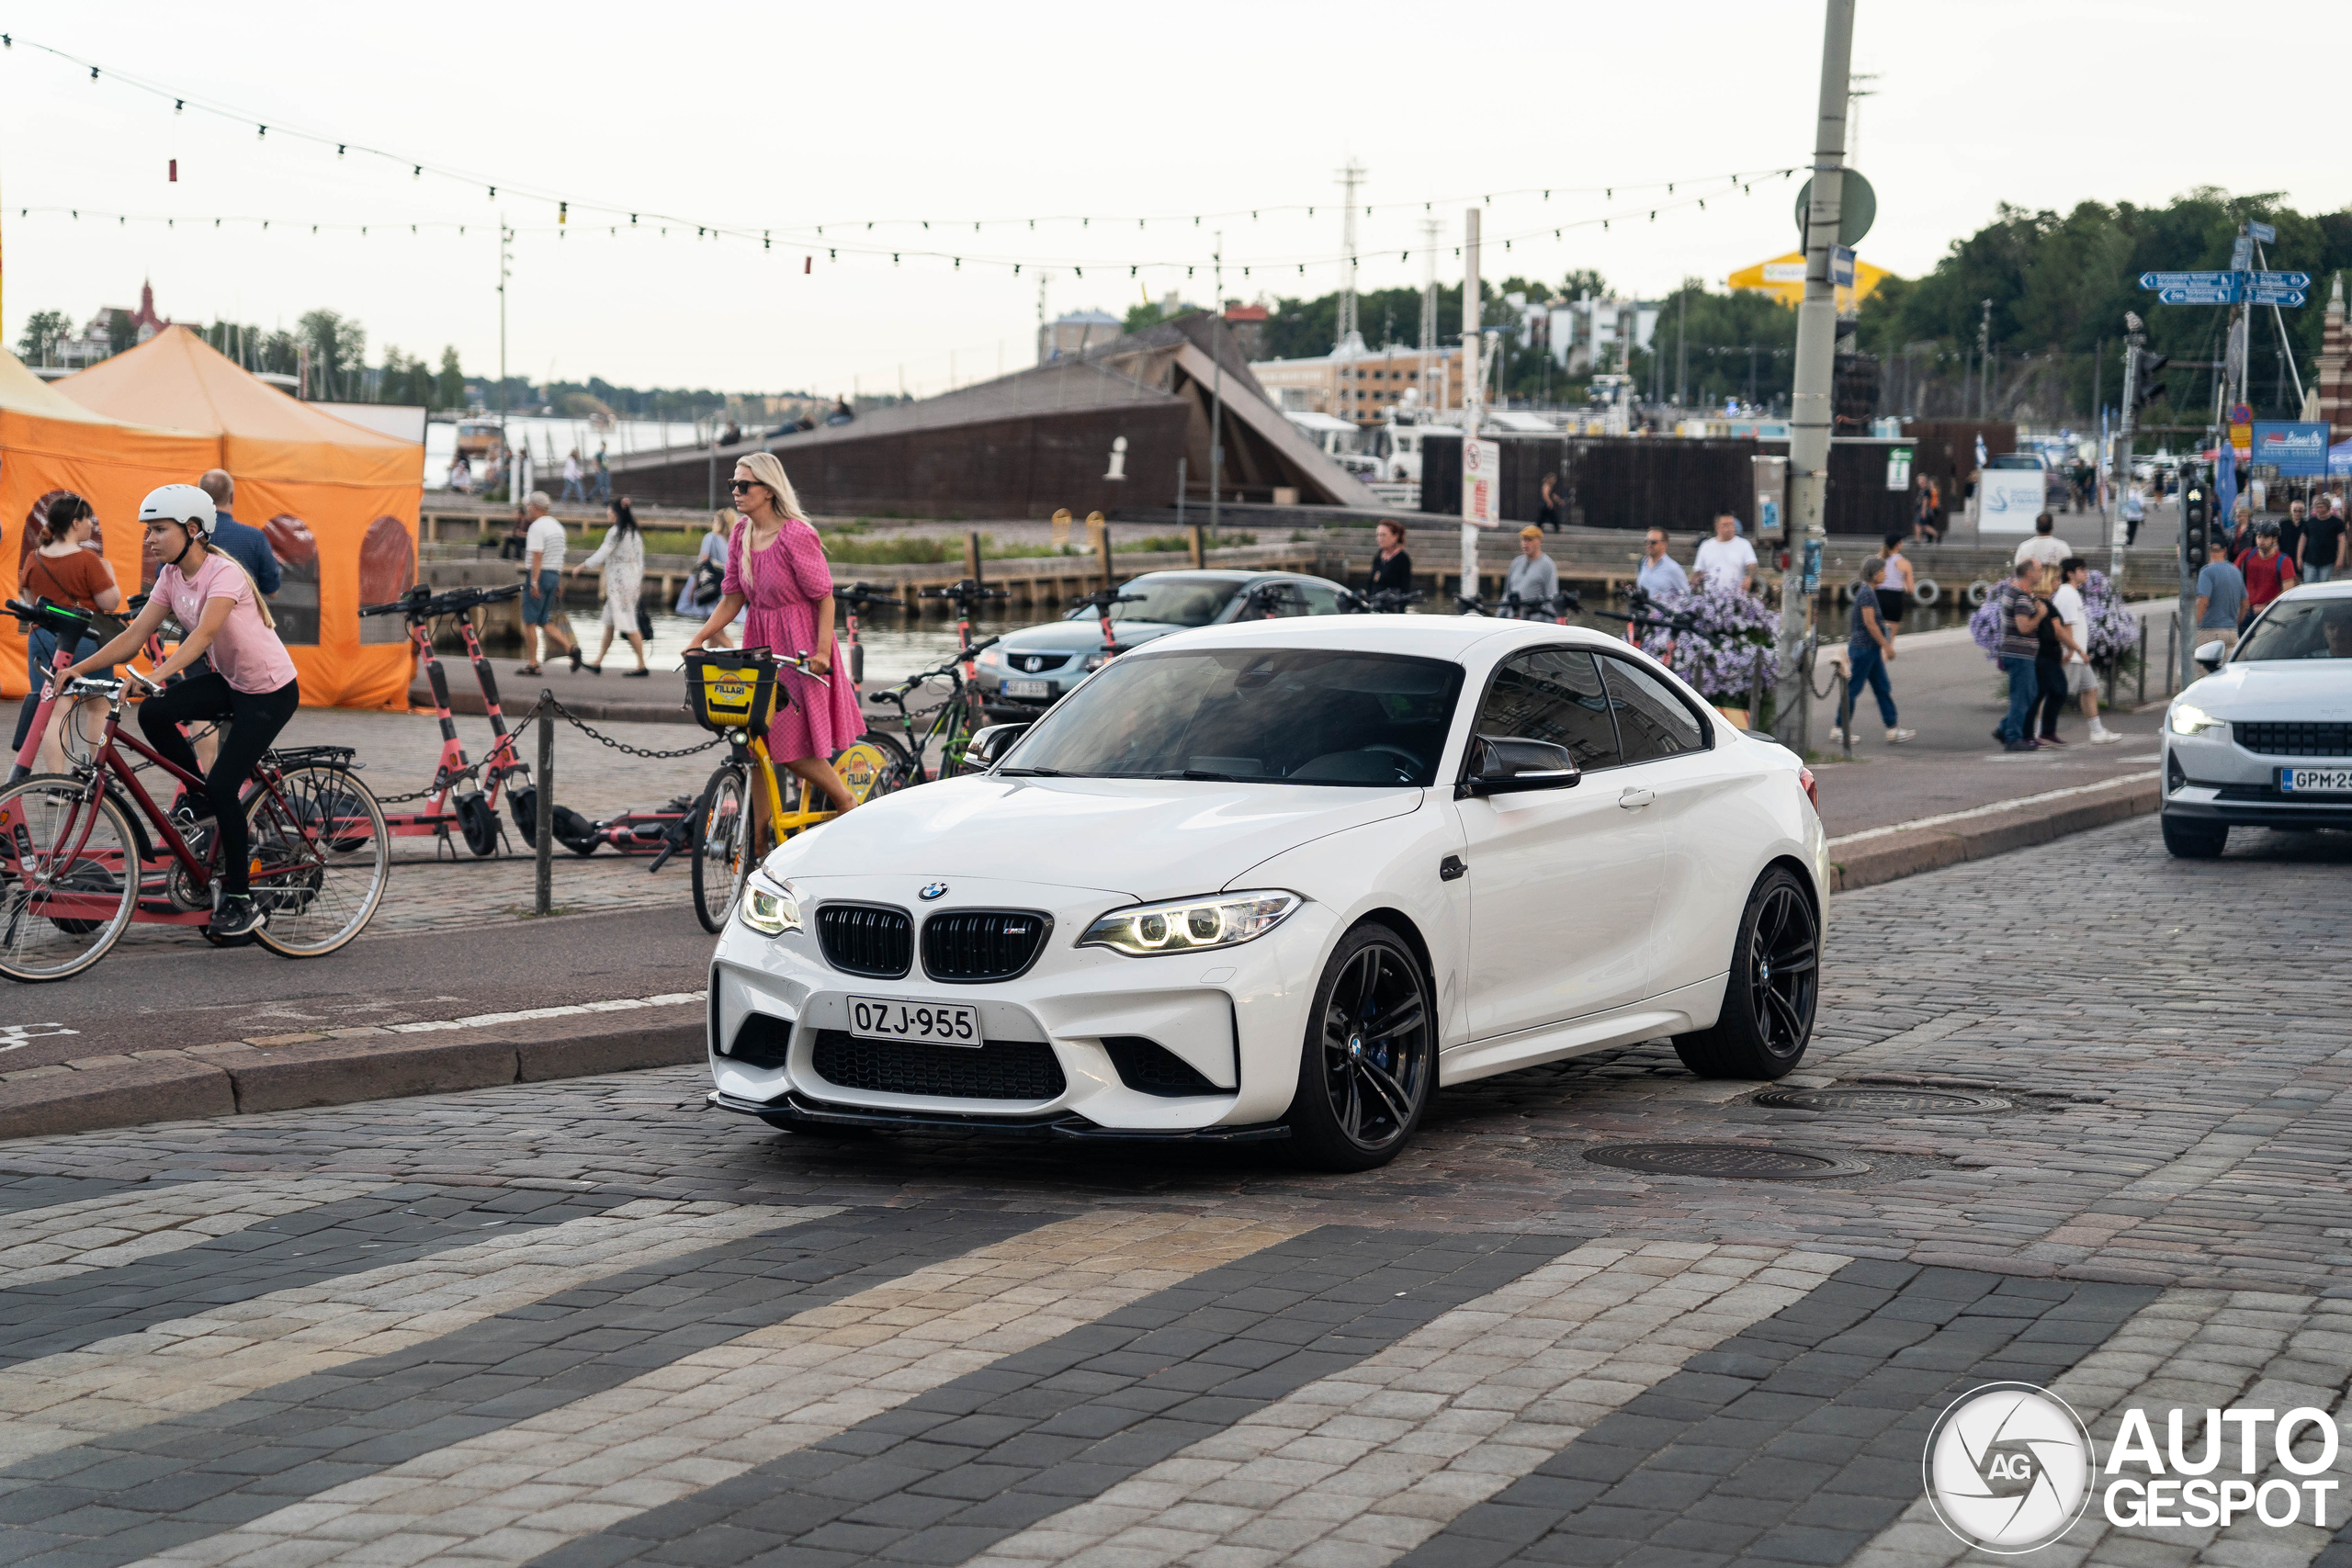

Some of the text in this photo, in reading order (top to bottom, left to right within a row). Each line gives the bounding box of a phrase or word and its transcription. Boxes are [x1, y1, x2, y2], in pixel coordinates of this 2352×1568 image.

[714, 684, 745, 695] FILLARI
[847, 773, 871, 786] FILLARI
[855, 1003, 973, 1039] OZJ-955
